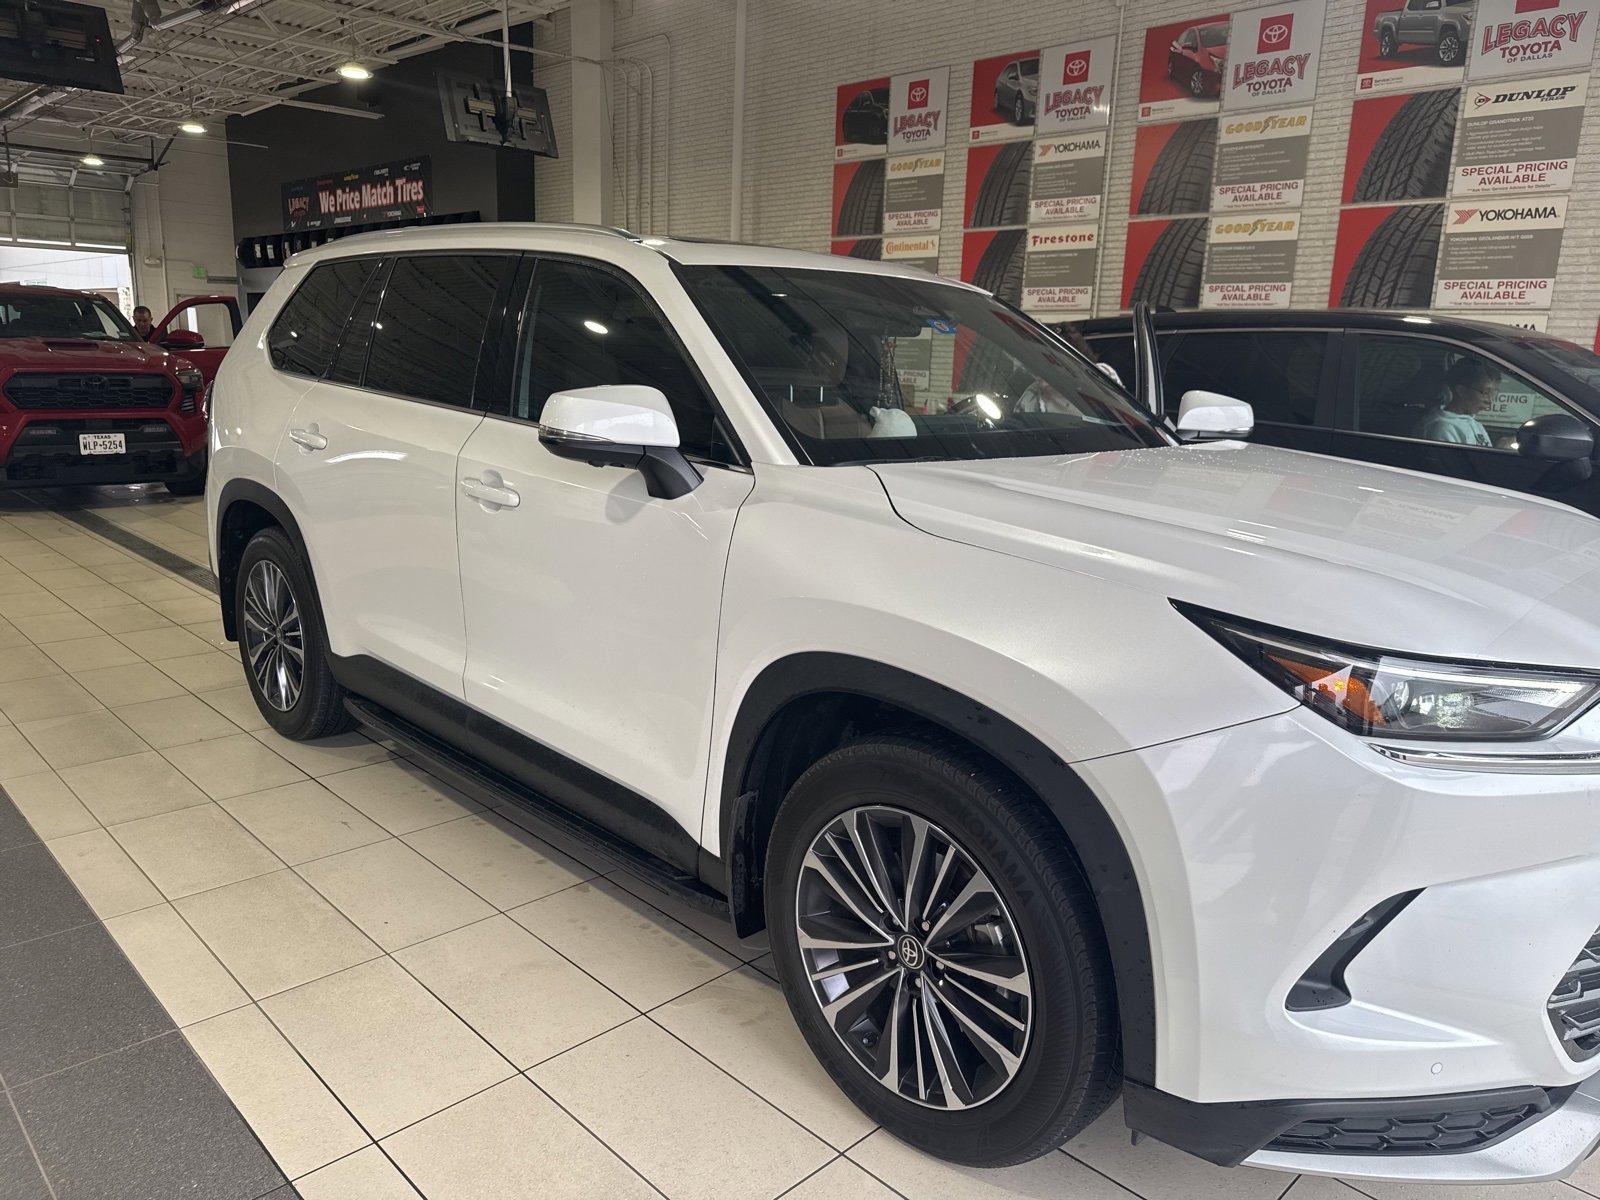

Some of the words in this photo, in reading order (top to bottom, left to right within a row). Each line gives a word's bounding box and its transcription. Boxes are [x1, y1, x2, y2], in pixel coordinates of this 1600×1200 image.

[1481, 11, 1588, 56] LEGACY
[1499, 39, 1562, 59] TOYOTA
[1520, 53, 1553, 62] DALLAS
[1232, 53, 1311, 90] LEGACY
[1246, 77, 1293, 93] TOYOTA
[1261, 88, 1286, 96] DALLAS
[1491, 85, 1577, 104] DUNLOP
[1044, 85, 1105, 116] LEGACY
[1055, 106, 1091, 119] TOYOTA
[893, 110, 941, 138] LEGACY
[1225, 115, 1307, 134] GOODYEAR
[902, 129, 931, 140] TOYOTA
[1053, 140, 1101, 153] YOKOHAMA
[1461, 165, 1513, 177] SPECIAL
[1516, 160, 1569, 173] PRICING
[1478, 172, 1547, 186] AVAILABLE
[1218, 185, 1258, 195] SPECIAL
[1259, 181, 1299, 191] PRICING
[318, 189, 336, 214] We
[335, 186, 361, 212] Price
[361, 180, 394, 209] Match
[394, 176, 424, 203] Tires
[1231, 192, 1283, 203] AVAILABLE
[1034, 199, 1065, 209] SPECIAL
[1066, 197, 1097, 206] PRICING
[887, 212, 913, 221] SPECIAL
[913, 210, 939, 218] PRICING
[1045, 205, 1085, 216] AVAILABLE
[1479, 206, 1557, 221] YOKOHAMA
[896, 218, 929, 227] AVAILABLE
[1214, 219, 1296, 236] GOODYEAR
[1031, 233, 1094, 247] Firestone
[885, 240, 929, 255] Continental
[1027, 288, 1057, 296] SPECIAL
[1058, 287, 1089, 295] PRICING
[1208, 284, 1246, 293] SPECIAL
[1248, 283, 1287, 293] PRICING
[1443, 281, 1494, 290] SPECIAL
[1496, 280, 1548, 290] PRICING
[1037, 295, 1077, 303] AVAILABLE
[1220, 293, 1271, 302] AVAILABLE
[1460, 290, 1527, 300] AVAILABLE
[1495, 394, 1528, 404] ICING
